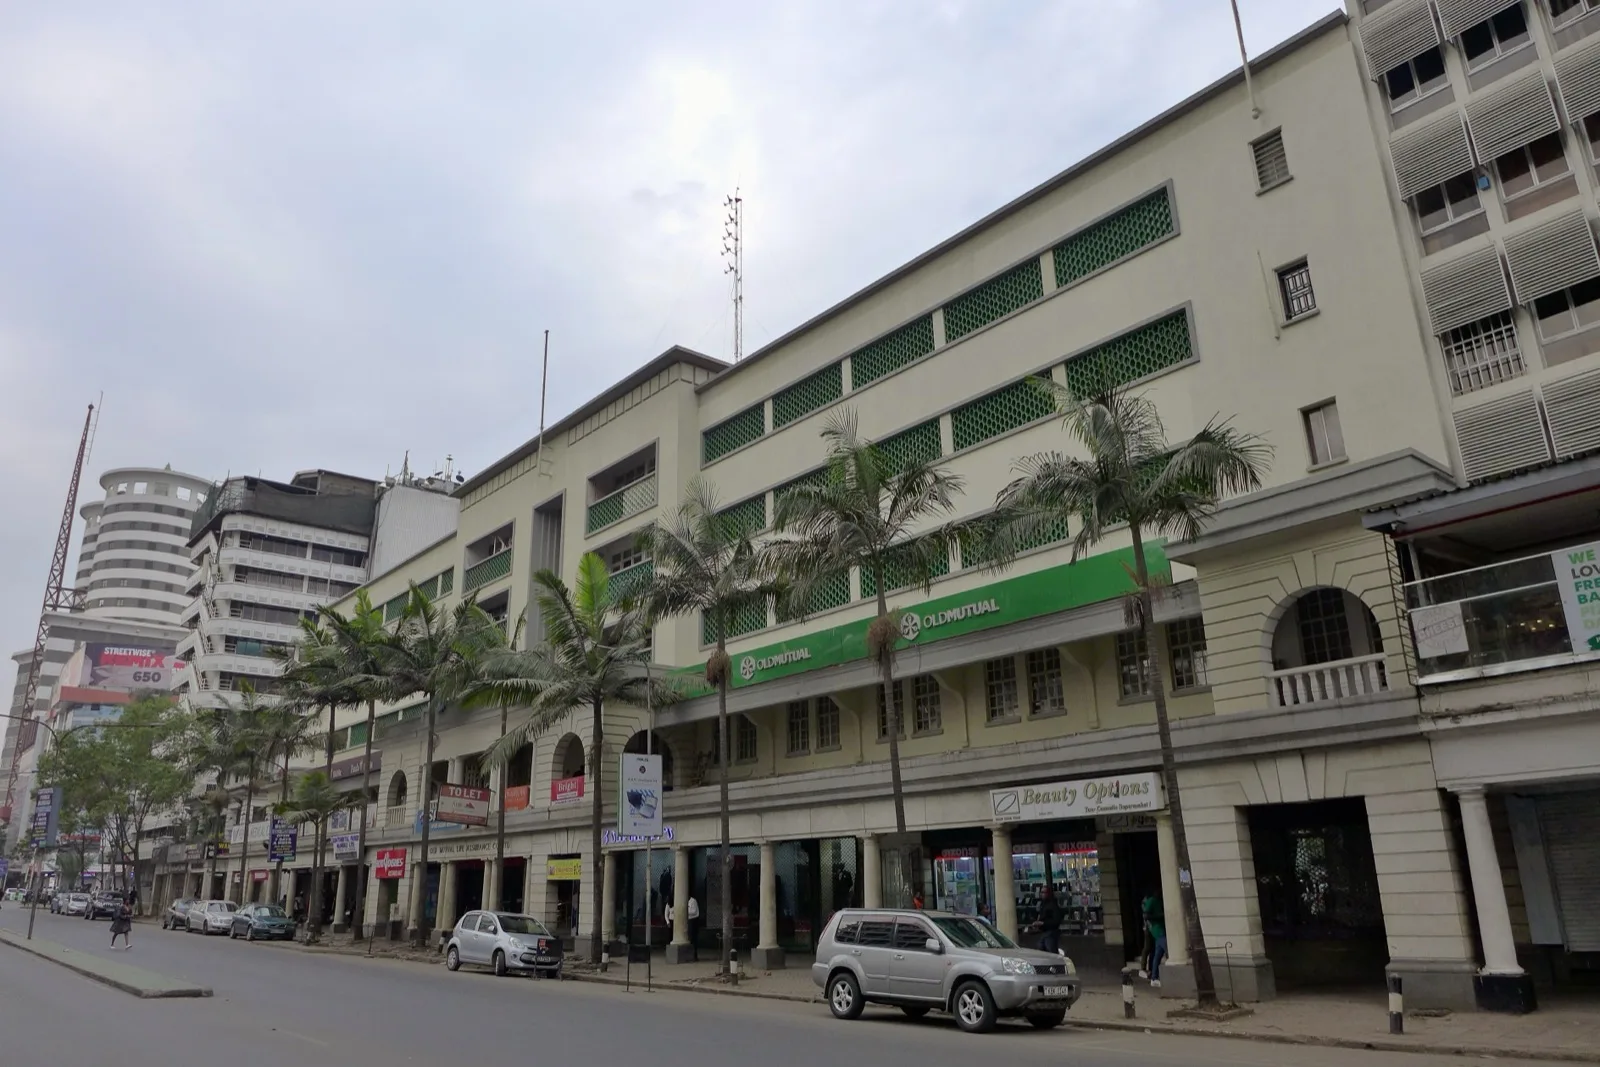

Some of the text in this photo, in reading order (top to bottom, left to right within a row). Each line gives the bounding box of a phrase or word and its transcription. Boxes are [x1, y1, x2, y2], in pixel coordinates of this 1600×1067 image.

[1568, 549, 1595, 564] WE
[923, 599, 1000, 629] OLDMUTUAL
[756, 648, 811, 671] OLDMUTUAL
[133, 671, 161, 682] 650
[449, 786, 482, 799] TO LET
[1021, 780, 1149, 807] Beauty Options
